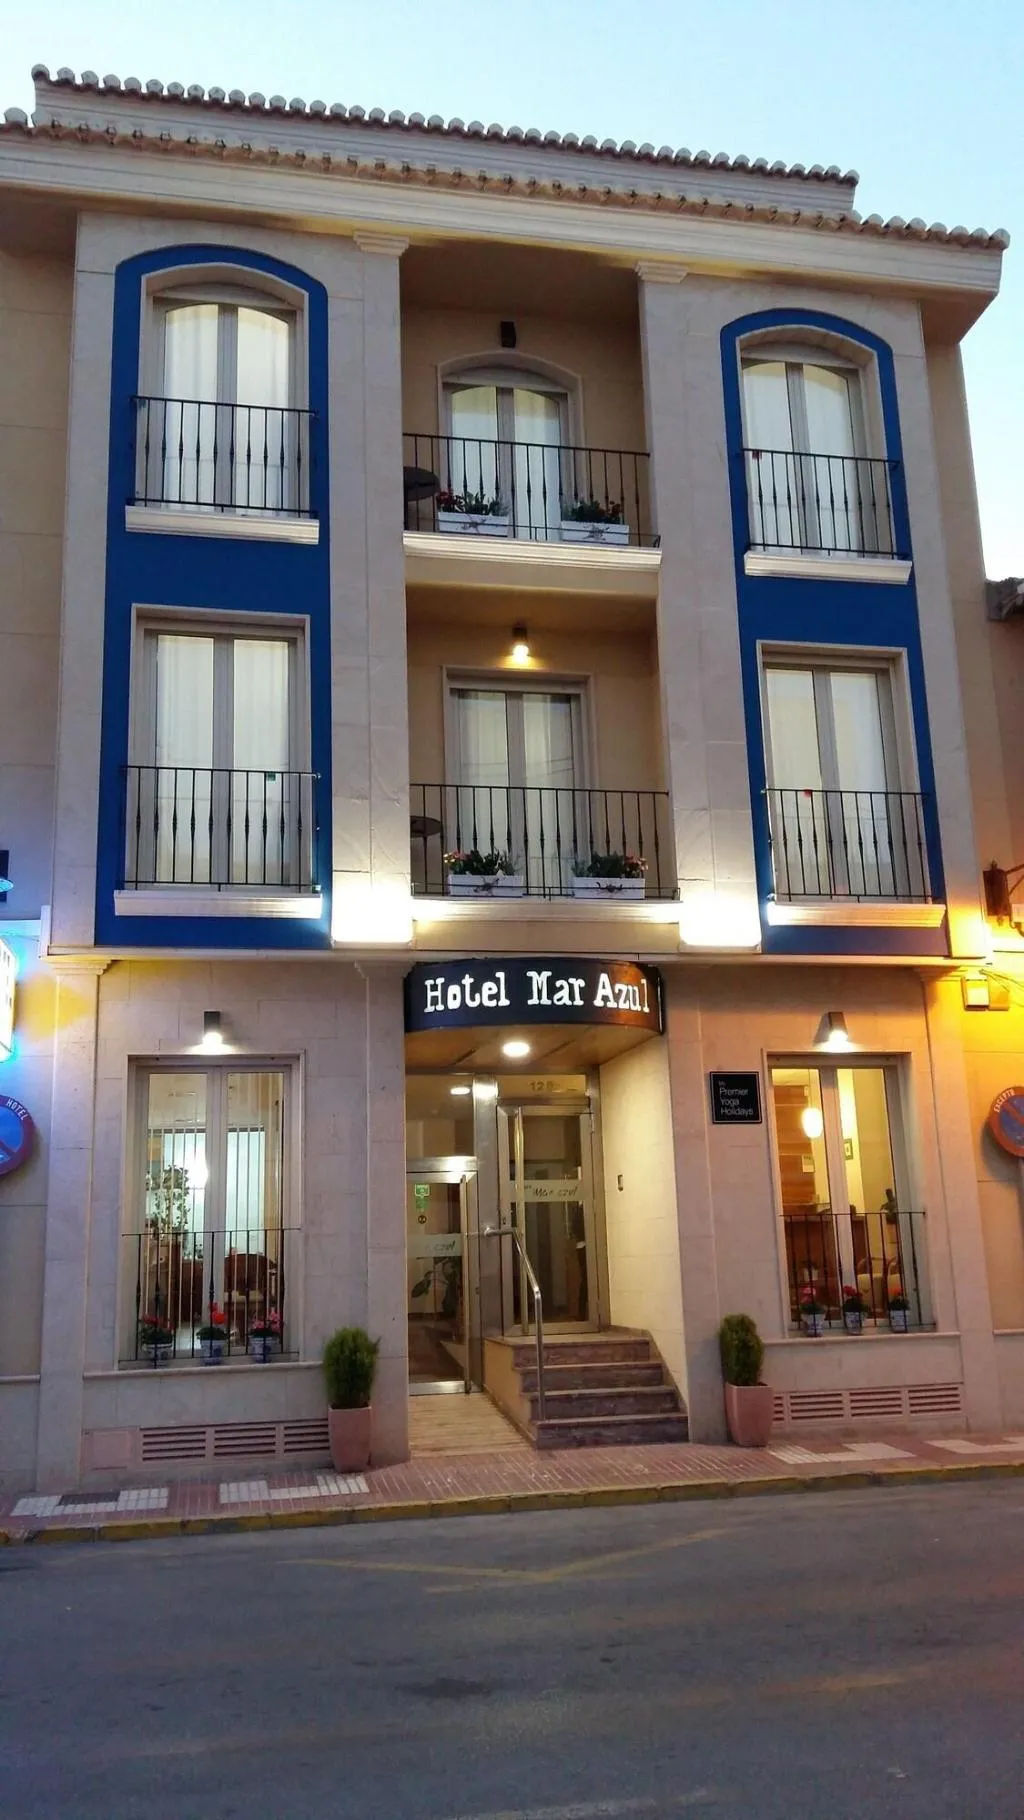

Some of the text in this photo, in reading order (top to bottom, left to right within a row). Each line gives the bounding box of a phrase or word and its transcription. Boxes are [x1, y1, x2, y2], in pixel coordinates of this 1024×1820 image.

[424, 970, 650, 1013] Hotel Mar Azul
[719, 1087, 749, 1096] Premier
[720, 1098, 740, 1107] Yoga
[6, 1098, 29, 1121] HOTEL
[720, 1107, 754, 1117] Holidays
